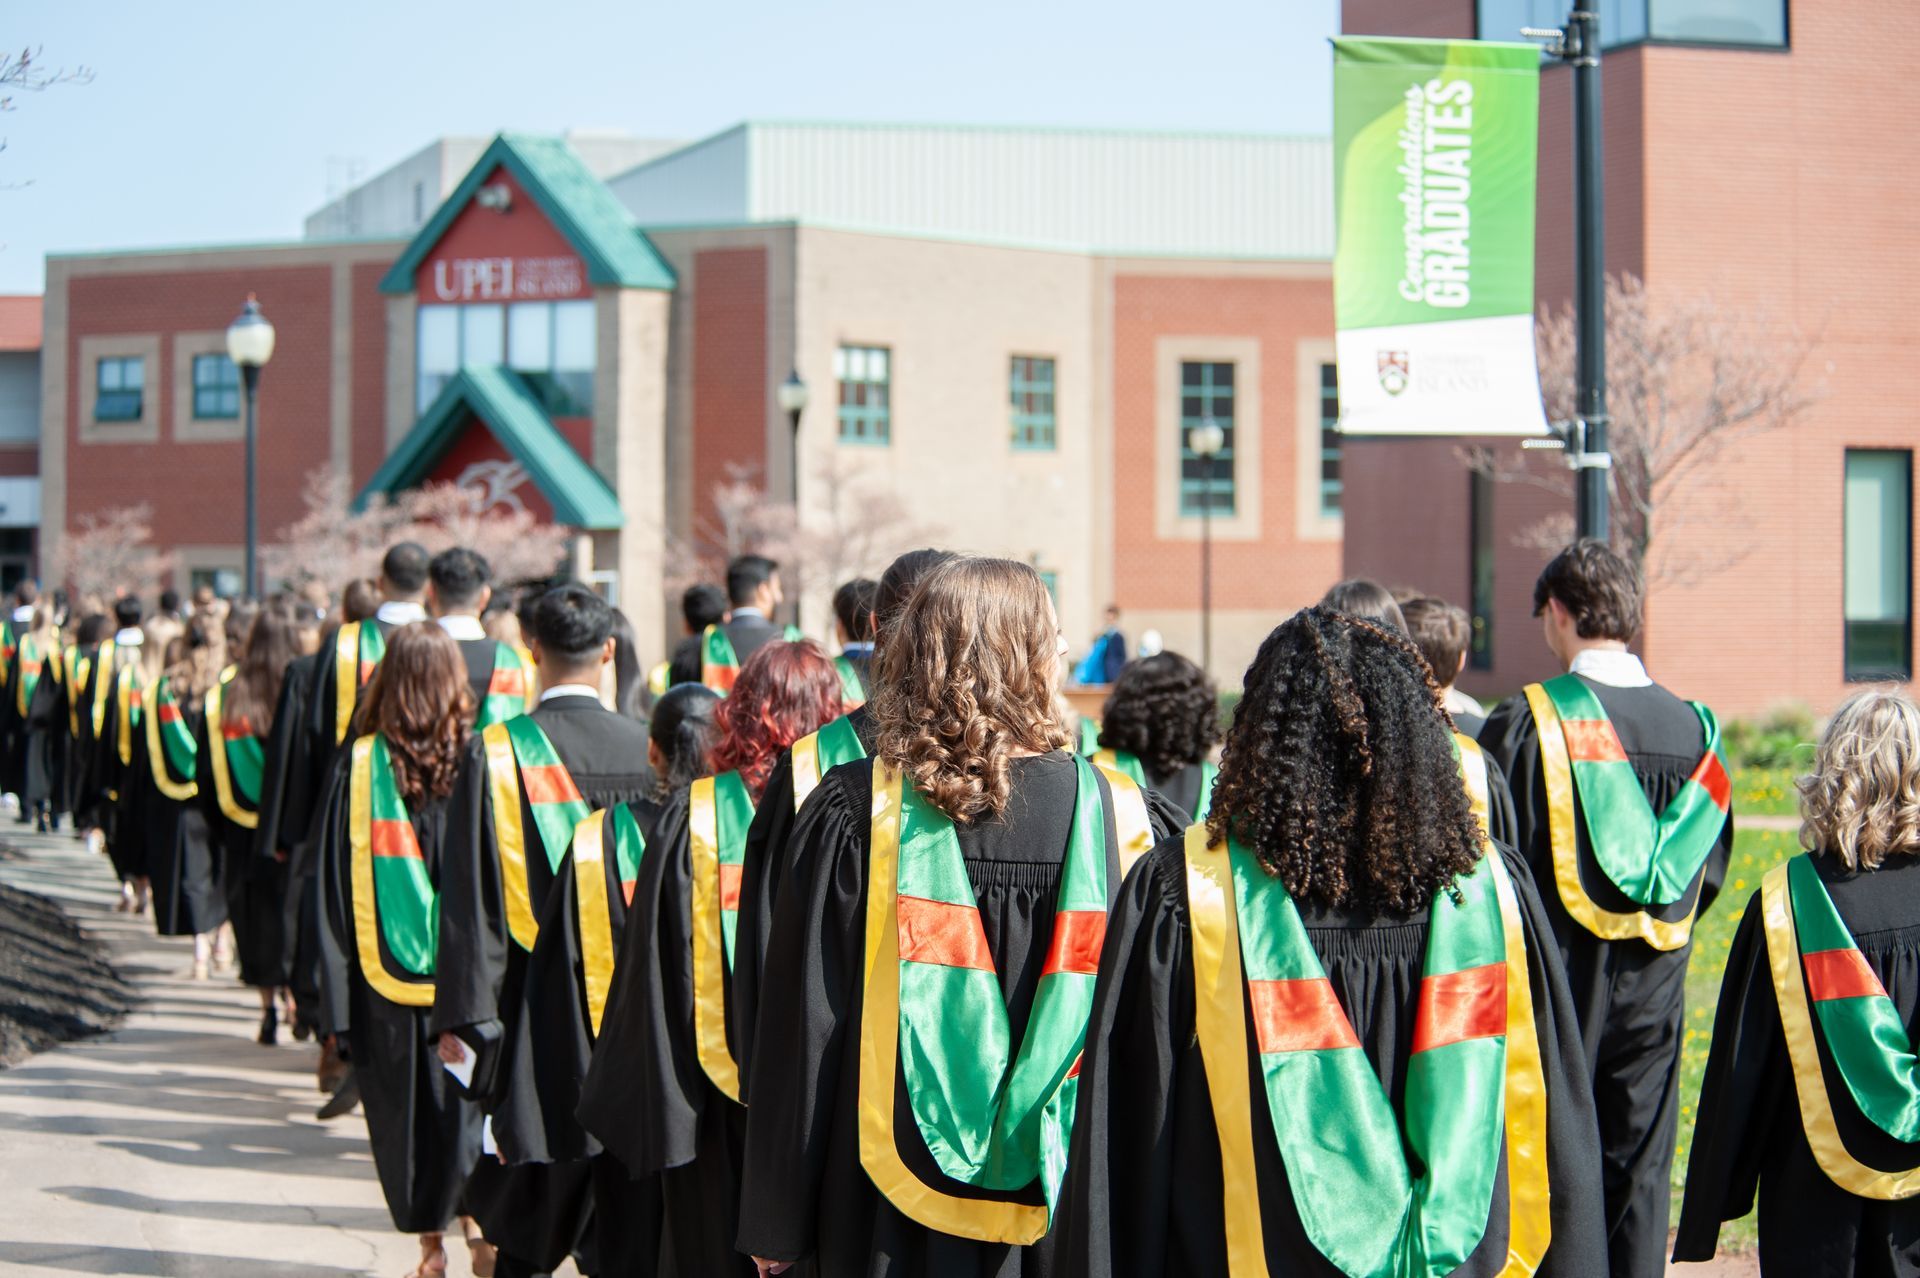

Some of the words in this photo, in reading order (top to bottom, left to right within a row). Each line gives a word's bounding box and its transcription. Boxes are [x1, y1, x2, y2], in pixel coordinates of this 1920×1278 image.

[434, 257, 513, 301] UPEI
[1397, 83, 1424, 302] Congratulations
[1424, 79, 1472, 308] GRADUATES
